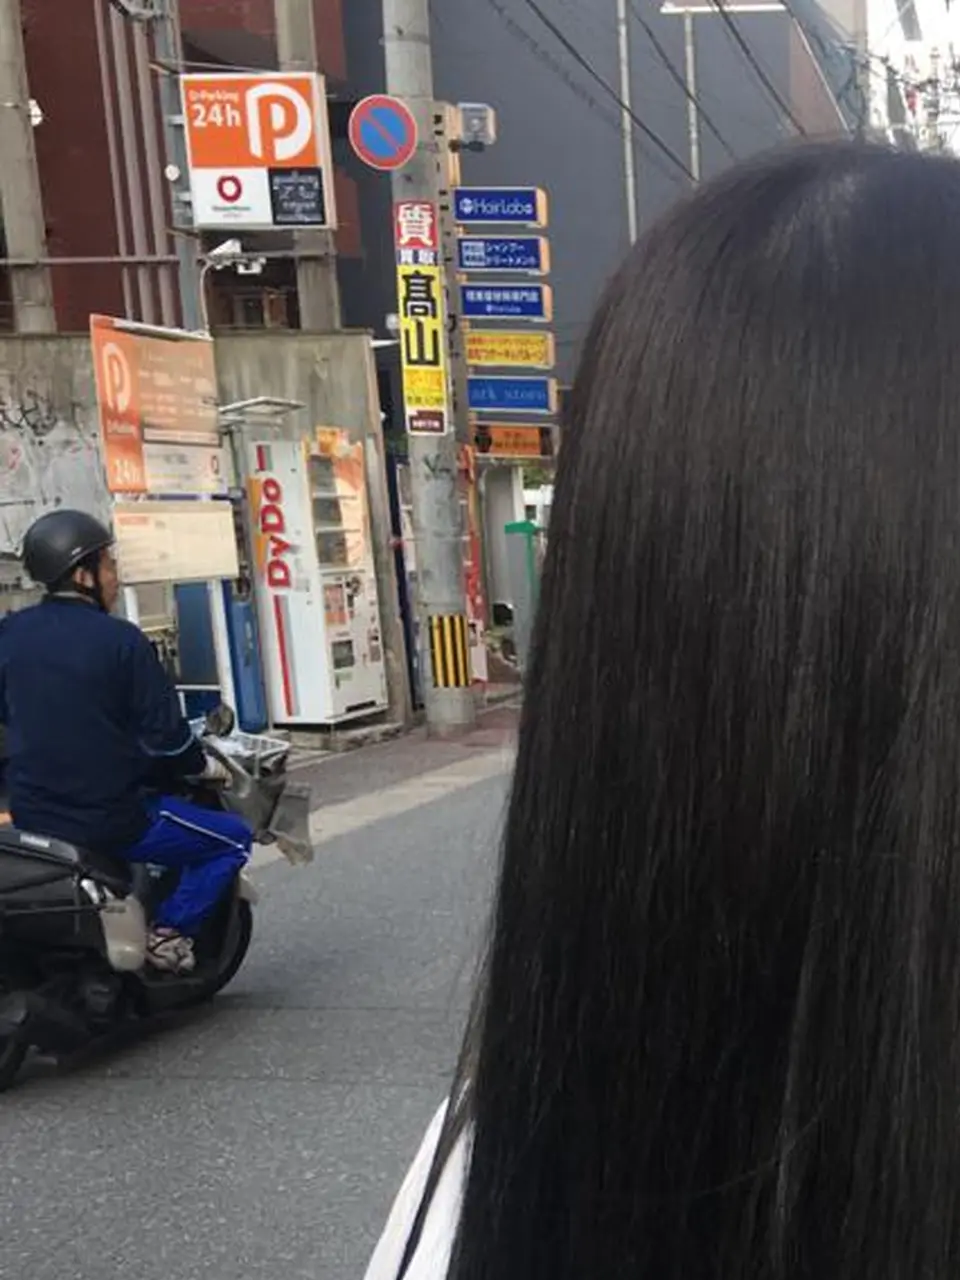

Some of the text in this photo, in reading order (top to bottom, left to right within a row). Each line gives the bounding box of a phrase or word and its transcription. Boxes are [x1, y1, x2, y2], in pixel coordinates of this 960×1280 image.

[192, 102, 242, 128] 24h
[398, 203, 434, 246] 質
[261, 477, 292, 590] DyDo
